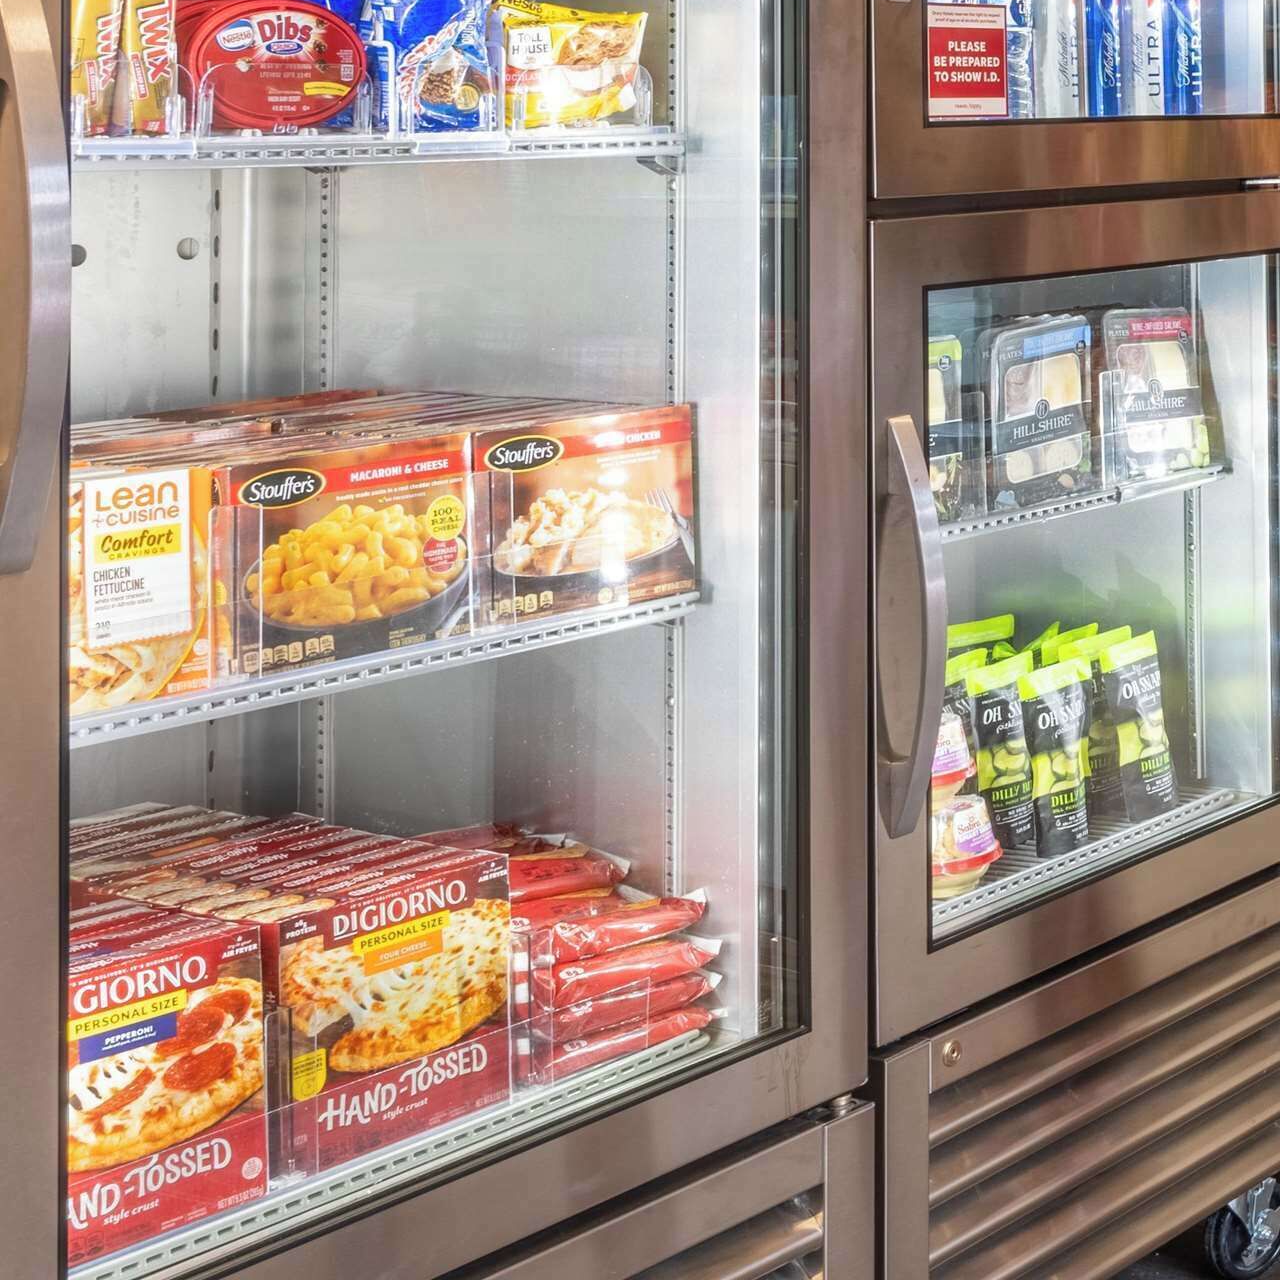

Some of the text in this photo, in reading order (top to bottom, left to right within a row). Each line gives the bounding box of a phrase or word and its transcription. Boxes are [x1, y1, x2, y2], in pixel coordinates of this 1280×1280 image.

[257, 15, 313, 43] Dibs
[948, 41, 986, 52] PLEASE
[934, 56, 1000, 68] BE PREPARED
[934, 71, 1000, 83] TO SHOW I.D.
[1013, 414, 1072, 440] HILLSHIRE
[494, 442, 554, 465] Stouffer's
[350, 459, 449, 482] MACARONI & CHEESE
[95, 481, 178, 511] Lean
[248, 475, 316, 502] Stouffer's
[101, 529, 173, 553] Comfort
[109, 547, 165, 561] CRAVINGS
[94, 566, 130, 583] CHICKEN
[94, 578, 145, 596] FETTUCCINE
[360, 917, 444, 949] PERSONAL SIZE
[75, 996, 179, 1035] PERSONAL SIZE
[104, 1025, 153, 1046] PEPPERONI
[318, 1043, 488, 1131] HAND-TOSSED
[383, 1097, 428, 1121] style crust
[103, 1198, 160, 1226] style crust
